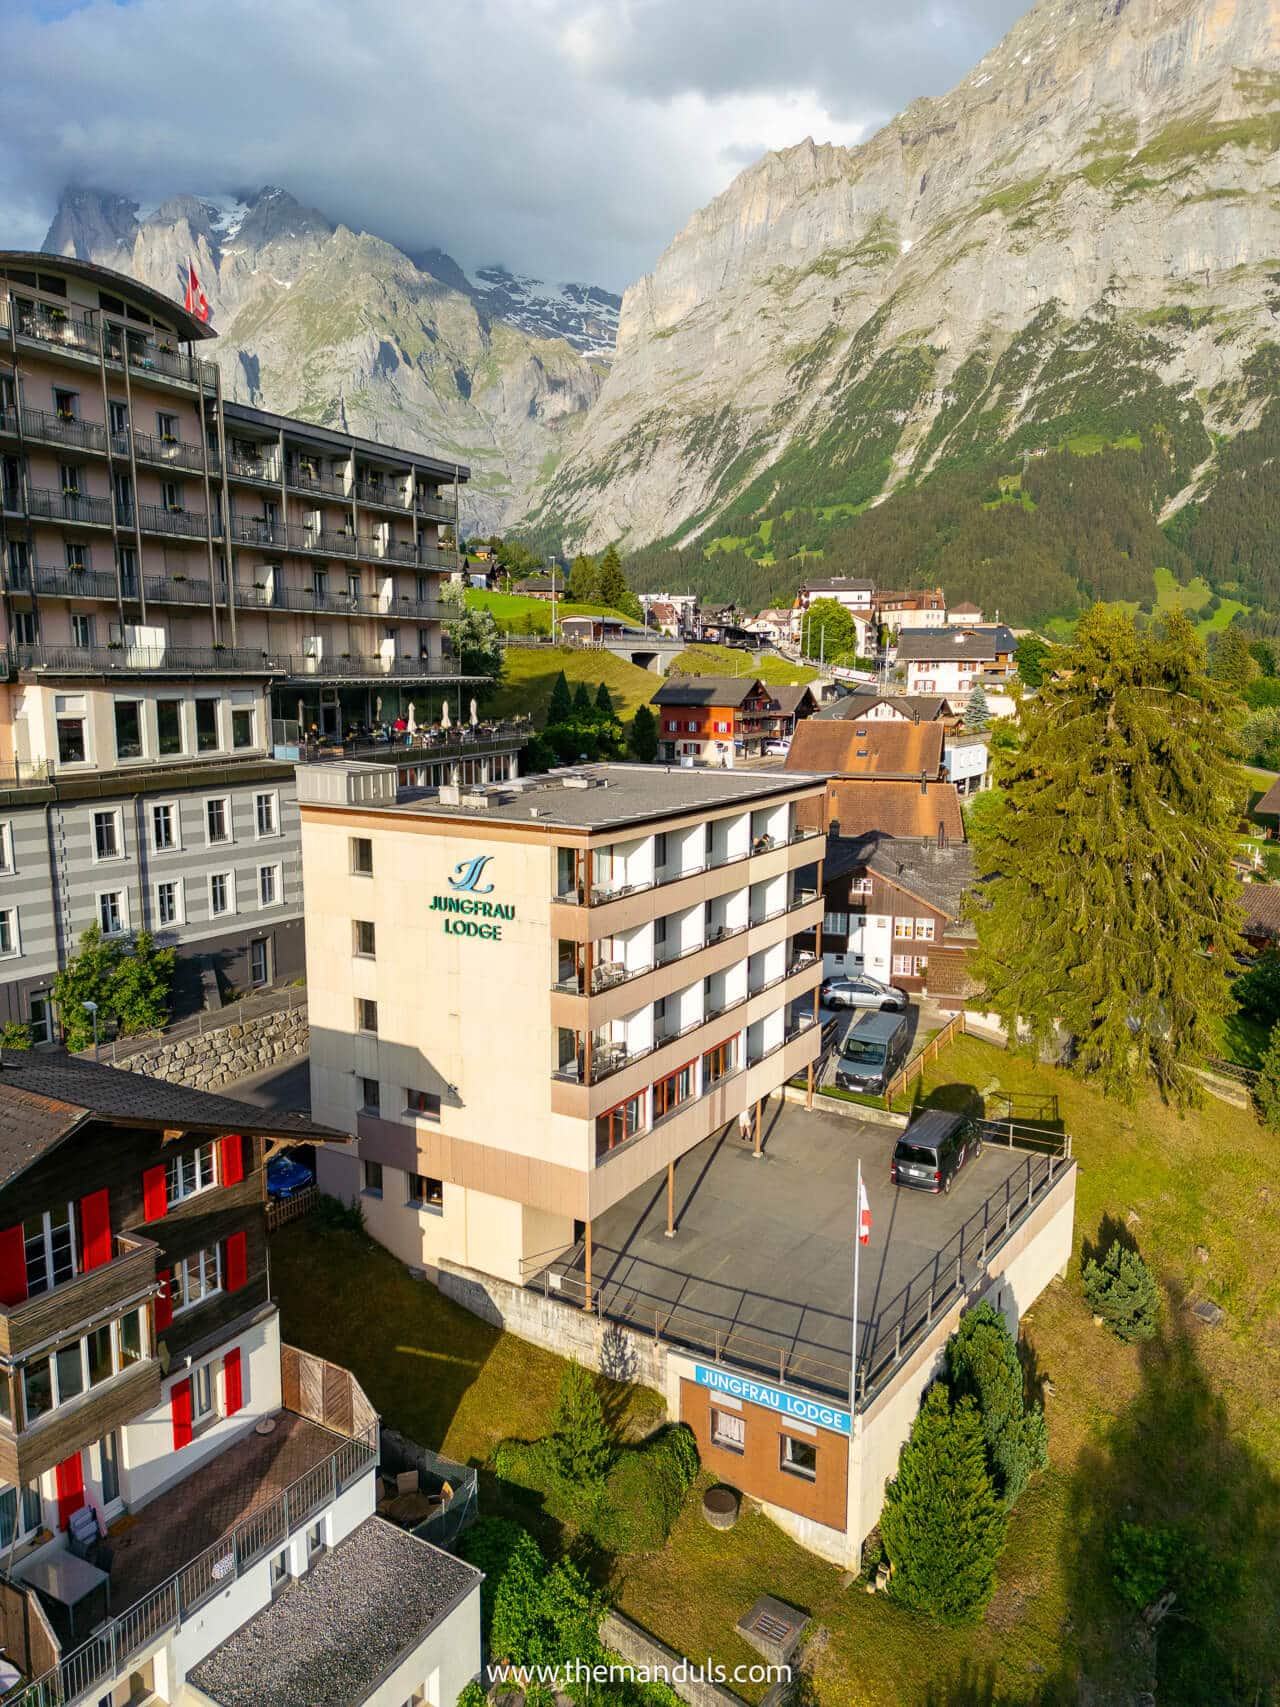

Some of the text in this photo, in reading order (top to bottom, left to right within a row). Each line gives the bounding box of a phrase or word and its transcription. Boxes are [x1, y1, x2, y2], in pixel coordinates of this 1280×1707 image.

[429, 896, 515, 920] JUNGFRAU
[444, 919, 502, 941] LODGE
[702, 1370, 843, 1428] JUNGFRAU LODGE
